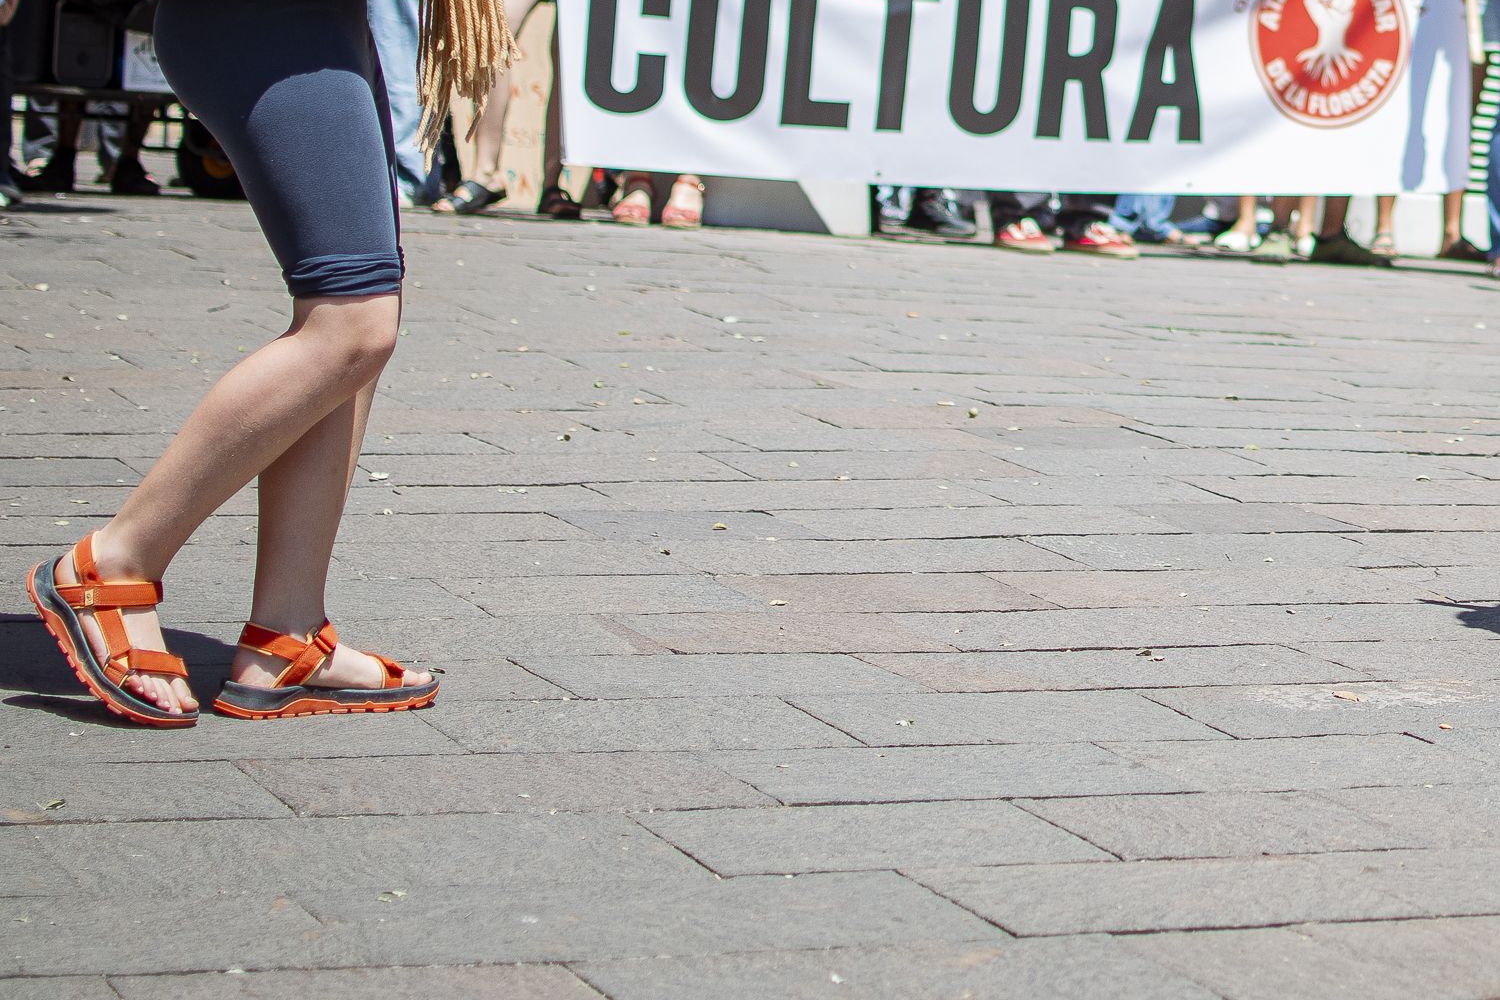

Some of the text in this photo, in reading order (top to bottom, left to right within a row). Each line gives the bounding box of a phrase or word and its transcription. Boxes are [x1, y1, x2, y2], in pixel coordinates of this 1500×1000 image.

[1266, 56, 1393, 116] DE LA FLORESTA
